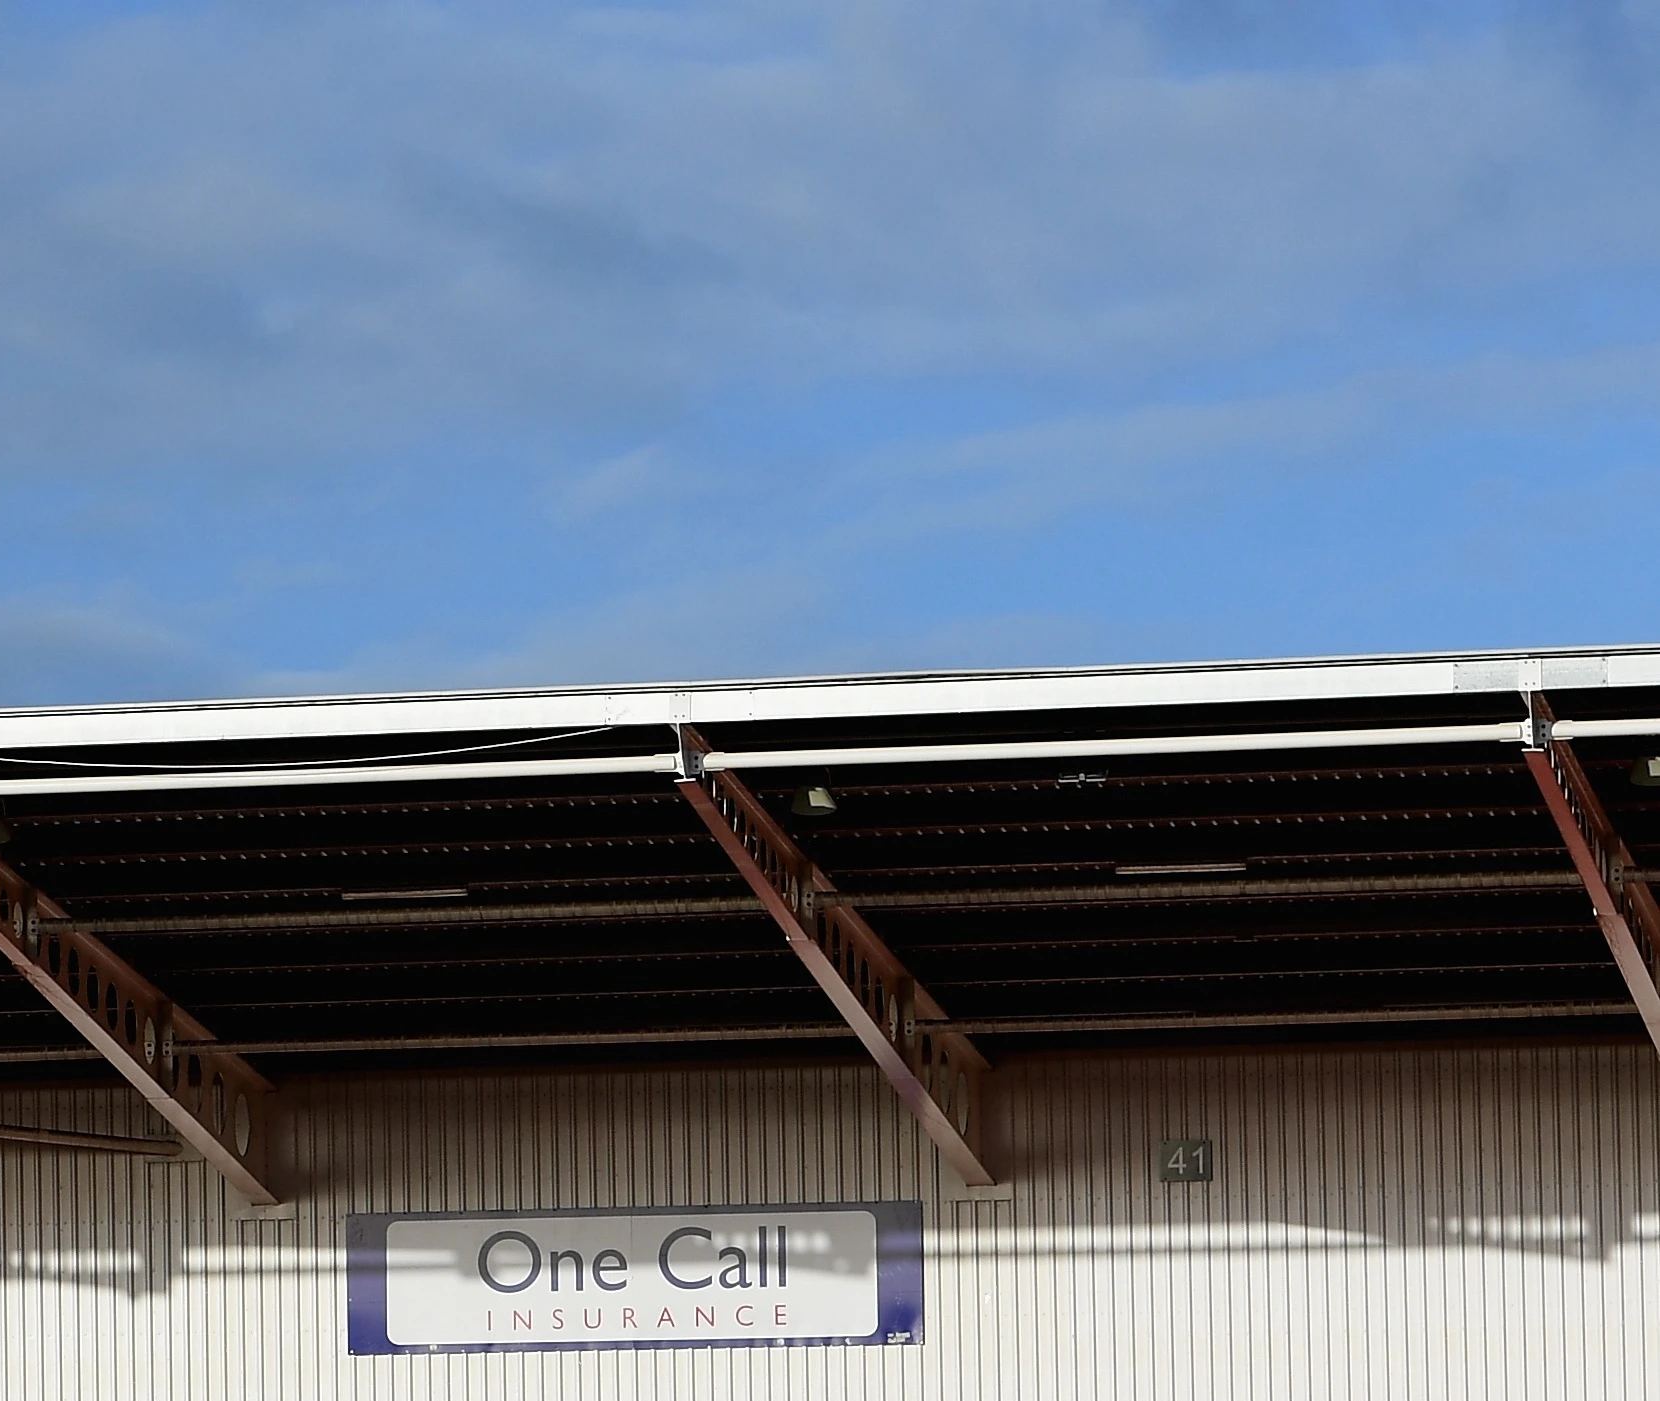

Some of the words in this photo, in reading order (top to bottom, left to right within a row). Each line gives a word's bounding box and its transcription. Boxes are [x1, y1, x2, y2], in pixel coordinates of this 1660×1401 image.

[1166, 1146, 1208, 1176] 41
[477, 1230, 628, 1294] One
[658, 1225, 787, 1290] Call
[486, 1304, 789, 1331] INSURANCE
